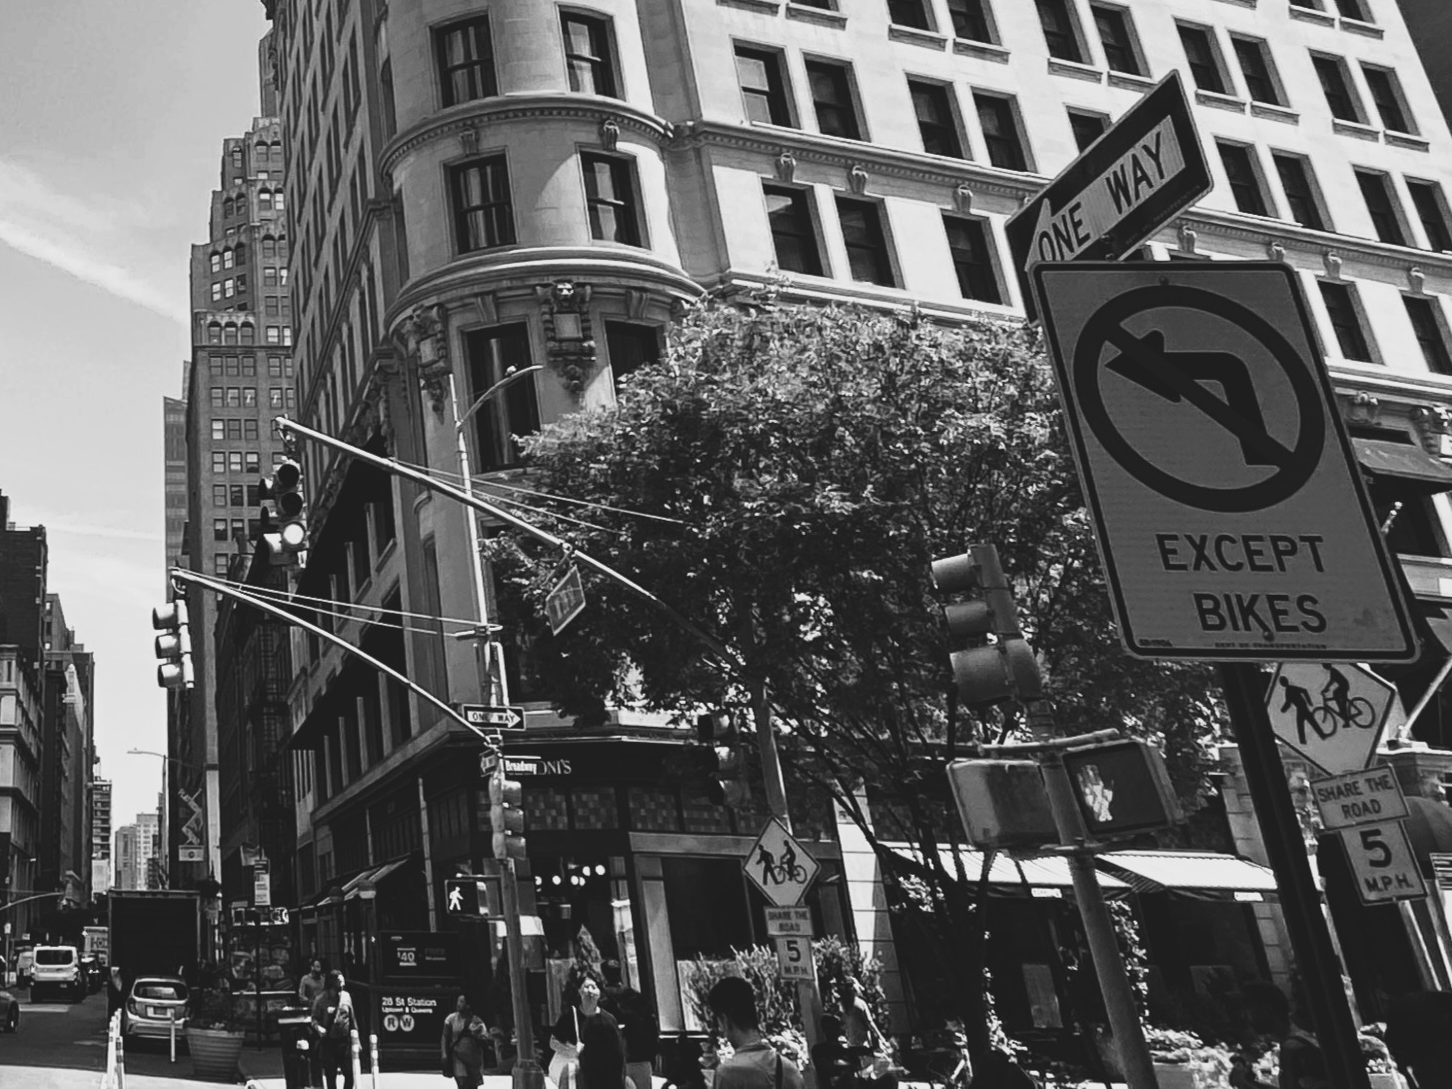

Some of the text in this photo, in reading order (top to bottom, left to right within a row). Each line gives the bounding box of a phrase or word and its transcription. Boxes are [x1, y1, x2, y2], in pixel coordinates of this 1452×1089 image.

[1038, 201, 1091, 261] ONE
[1105, 131, 1165, 215] WAY
[1155, 533, 1325, 573] EXCEPT
[1193, 592, 1327, 633] BIKES
[498, 714, 515, 723] WAY
[505, 760, 537, 775] Broadway
[1317, 774, 1394, 802] SHARE THE
[1341, 798, 1382, 819] ROAD
[1359, 828, 1392, 868] 5
[787, 940, 801, 962] 5
[407, 997, 437, 1006] Station
